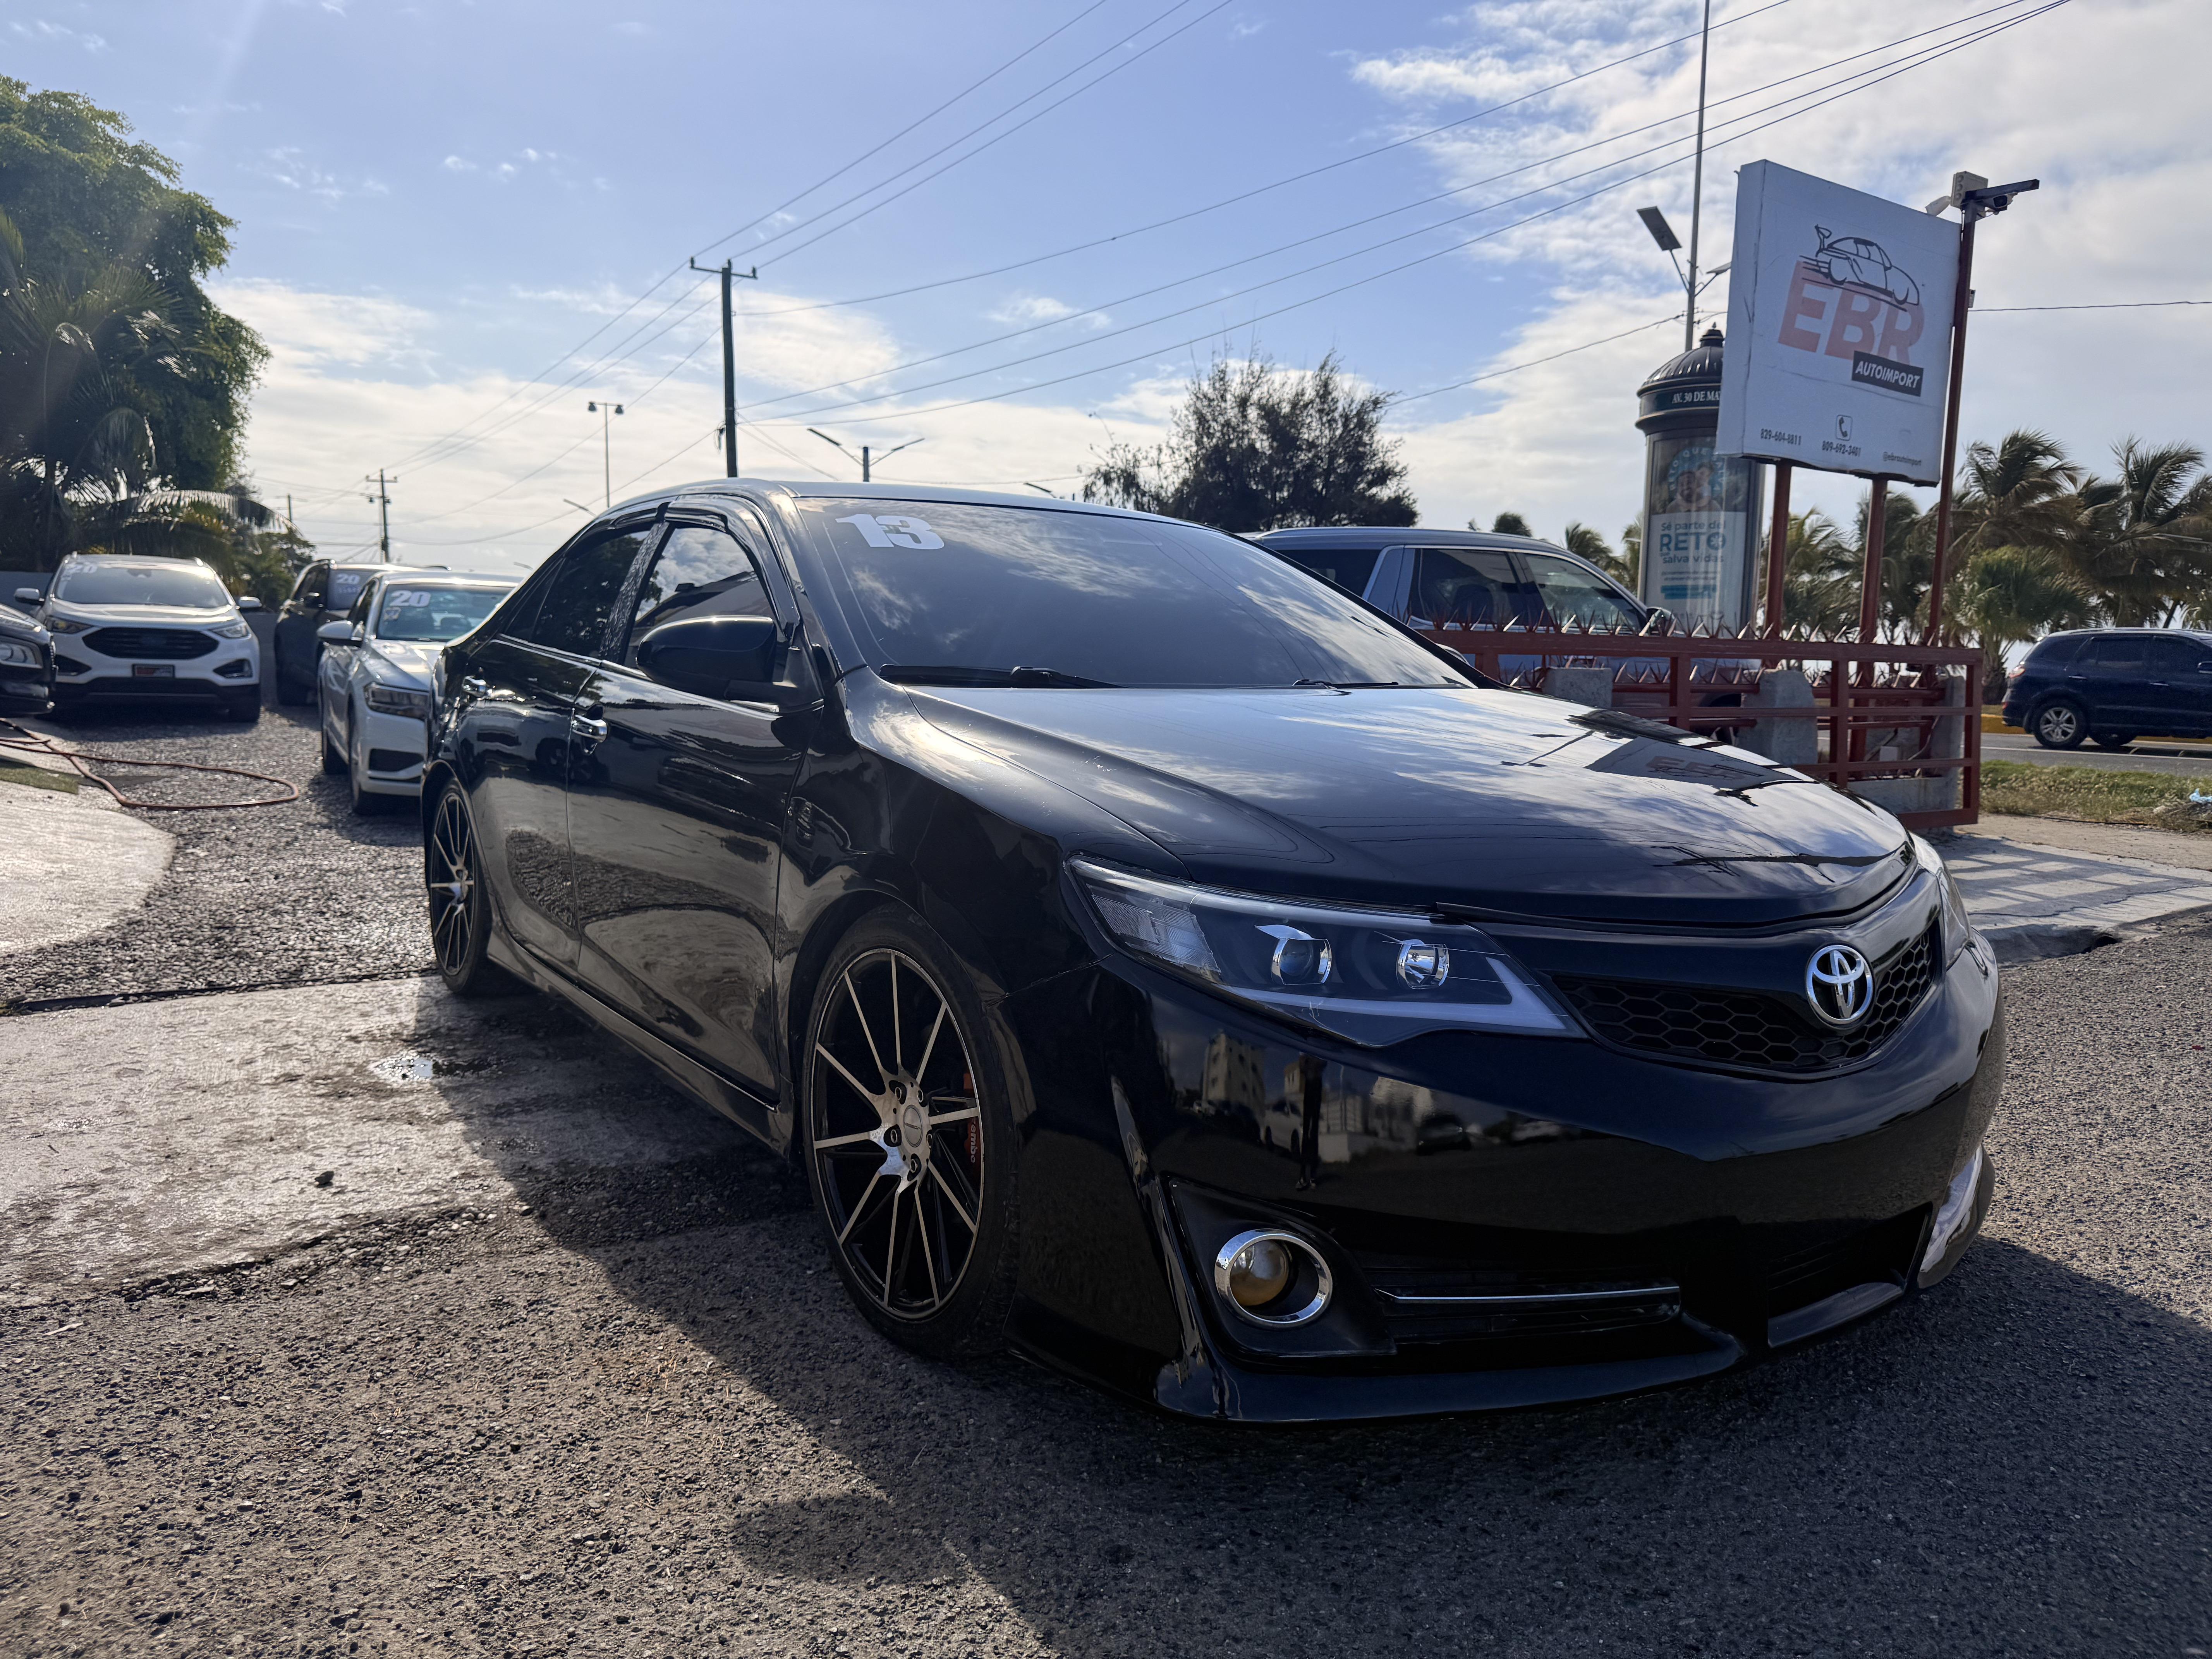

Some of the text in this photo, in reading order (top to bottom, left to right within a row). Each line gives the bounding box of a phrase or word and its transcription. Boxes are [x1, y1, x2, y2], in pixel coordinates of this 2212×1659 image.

[1778, 261, 1924, 365] EBR
[1855, 361, 1920, 388] AUTOIMPORT
[1672, 391, 1720, 404] AV. 30 DE MA
[1760, 428, 1802, 445] 829-604-8811
[835, 514, 945, 550] 13
[1674, 521, 1705, 532] parte
[1709, 520, 1726, 529] del
[1660, 532, 1726, 551] RETO
[1663, 554, 1724, 563] salva vidas
[337, 573, 361, 585] 20
[389, 590, 431, 608] 20
